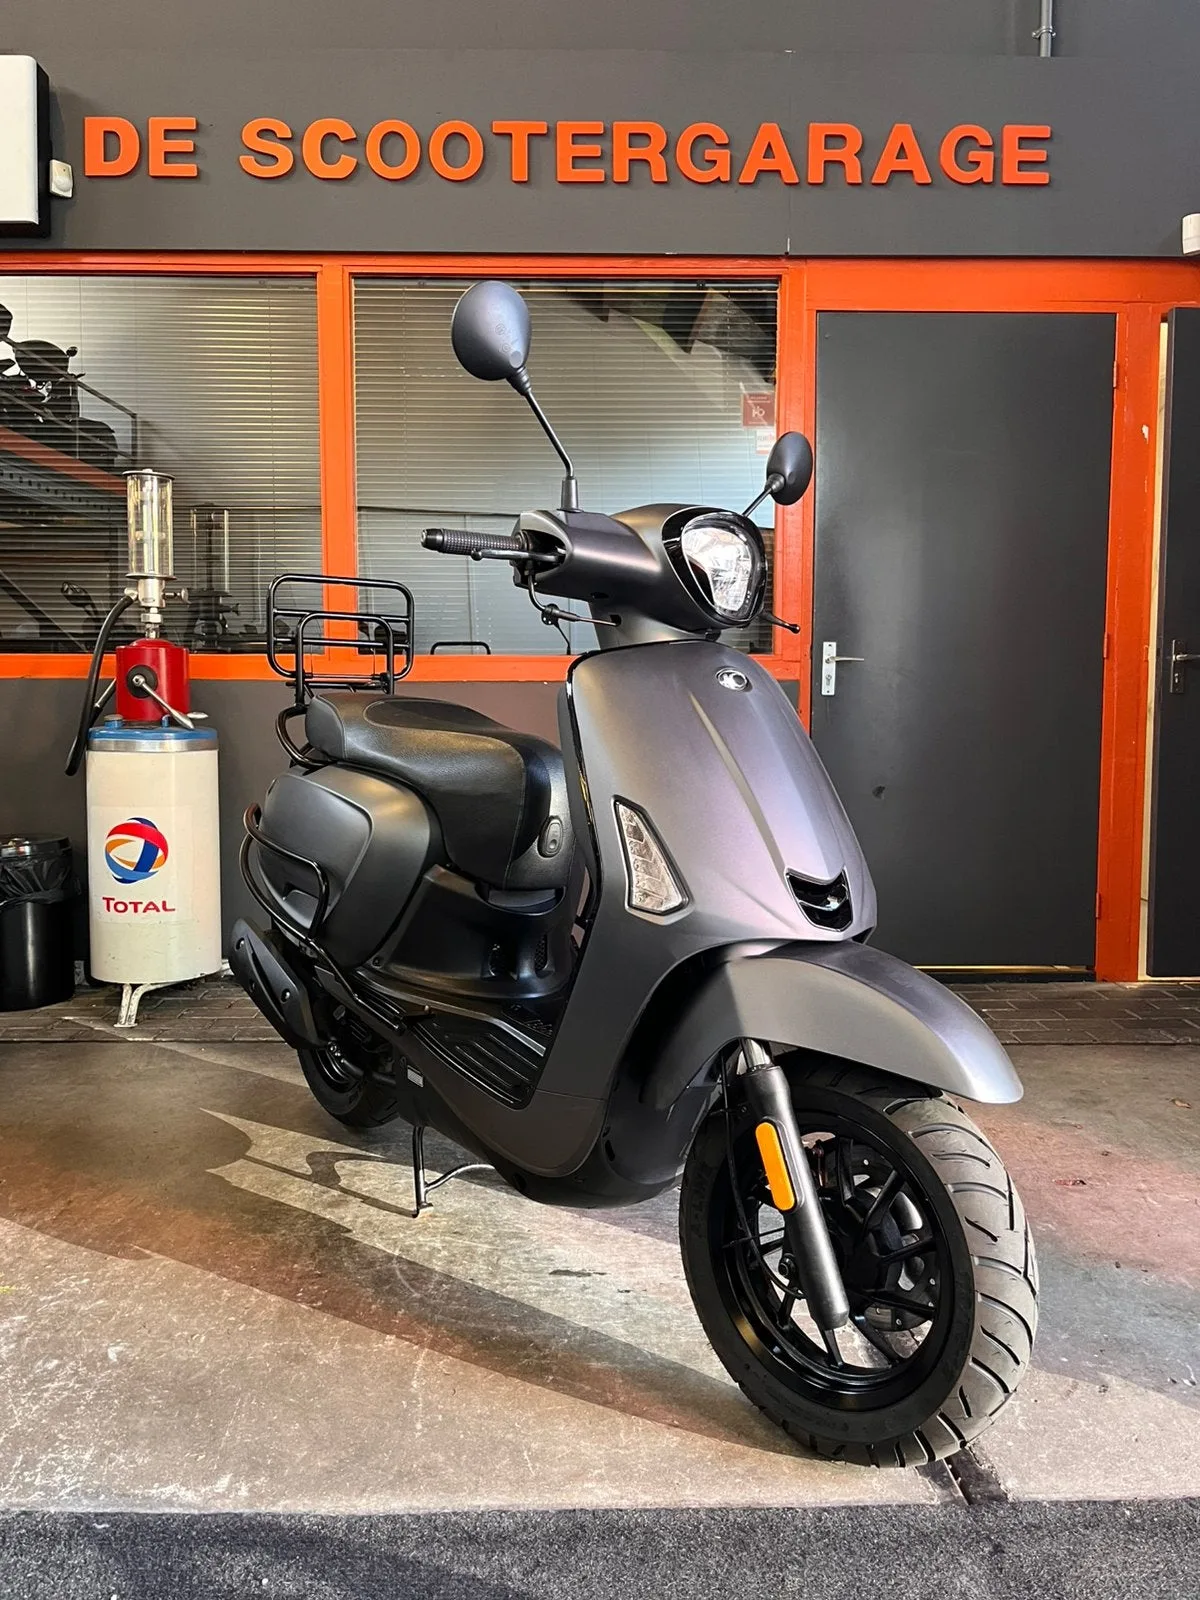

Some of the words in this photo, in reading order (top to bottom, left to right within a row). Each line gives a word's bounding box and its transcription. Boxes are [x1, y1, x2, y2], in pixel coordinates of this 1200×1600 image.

[84, 117, 198, 178] DE
[239, 119, 1051, 186] SCOOTERGARAGE
[102, 896, 176, 913] TOTAL
